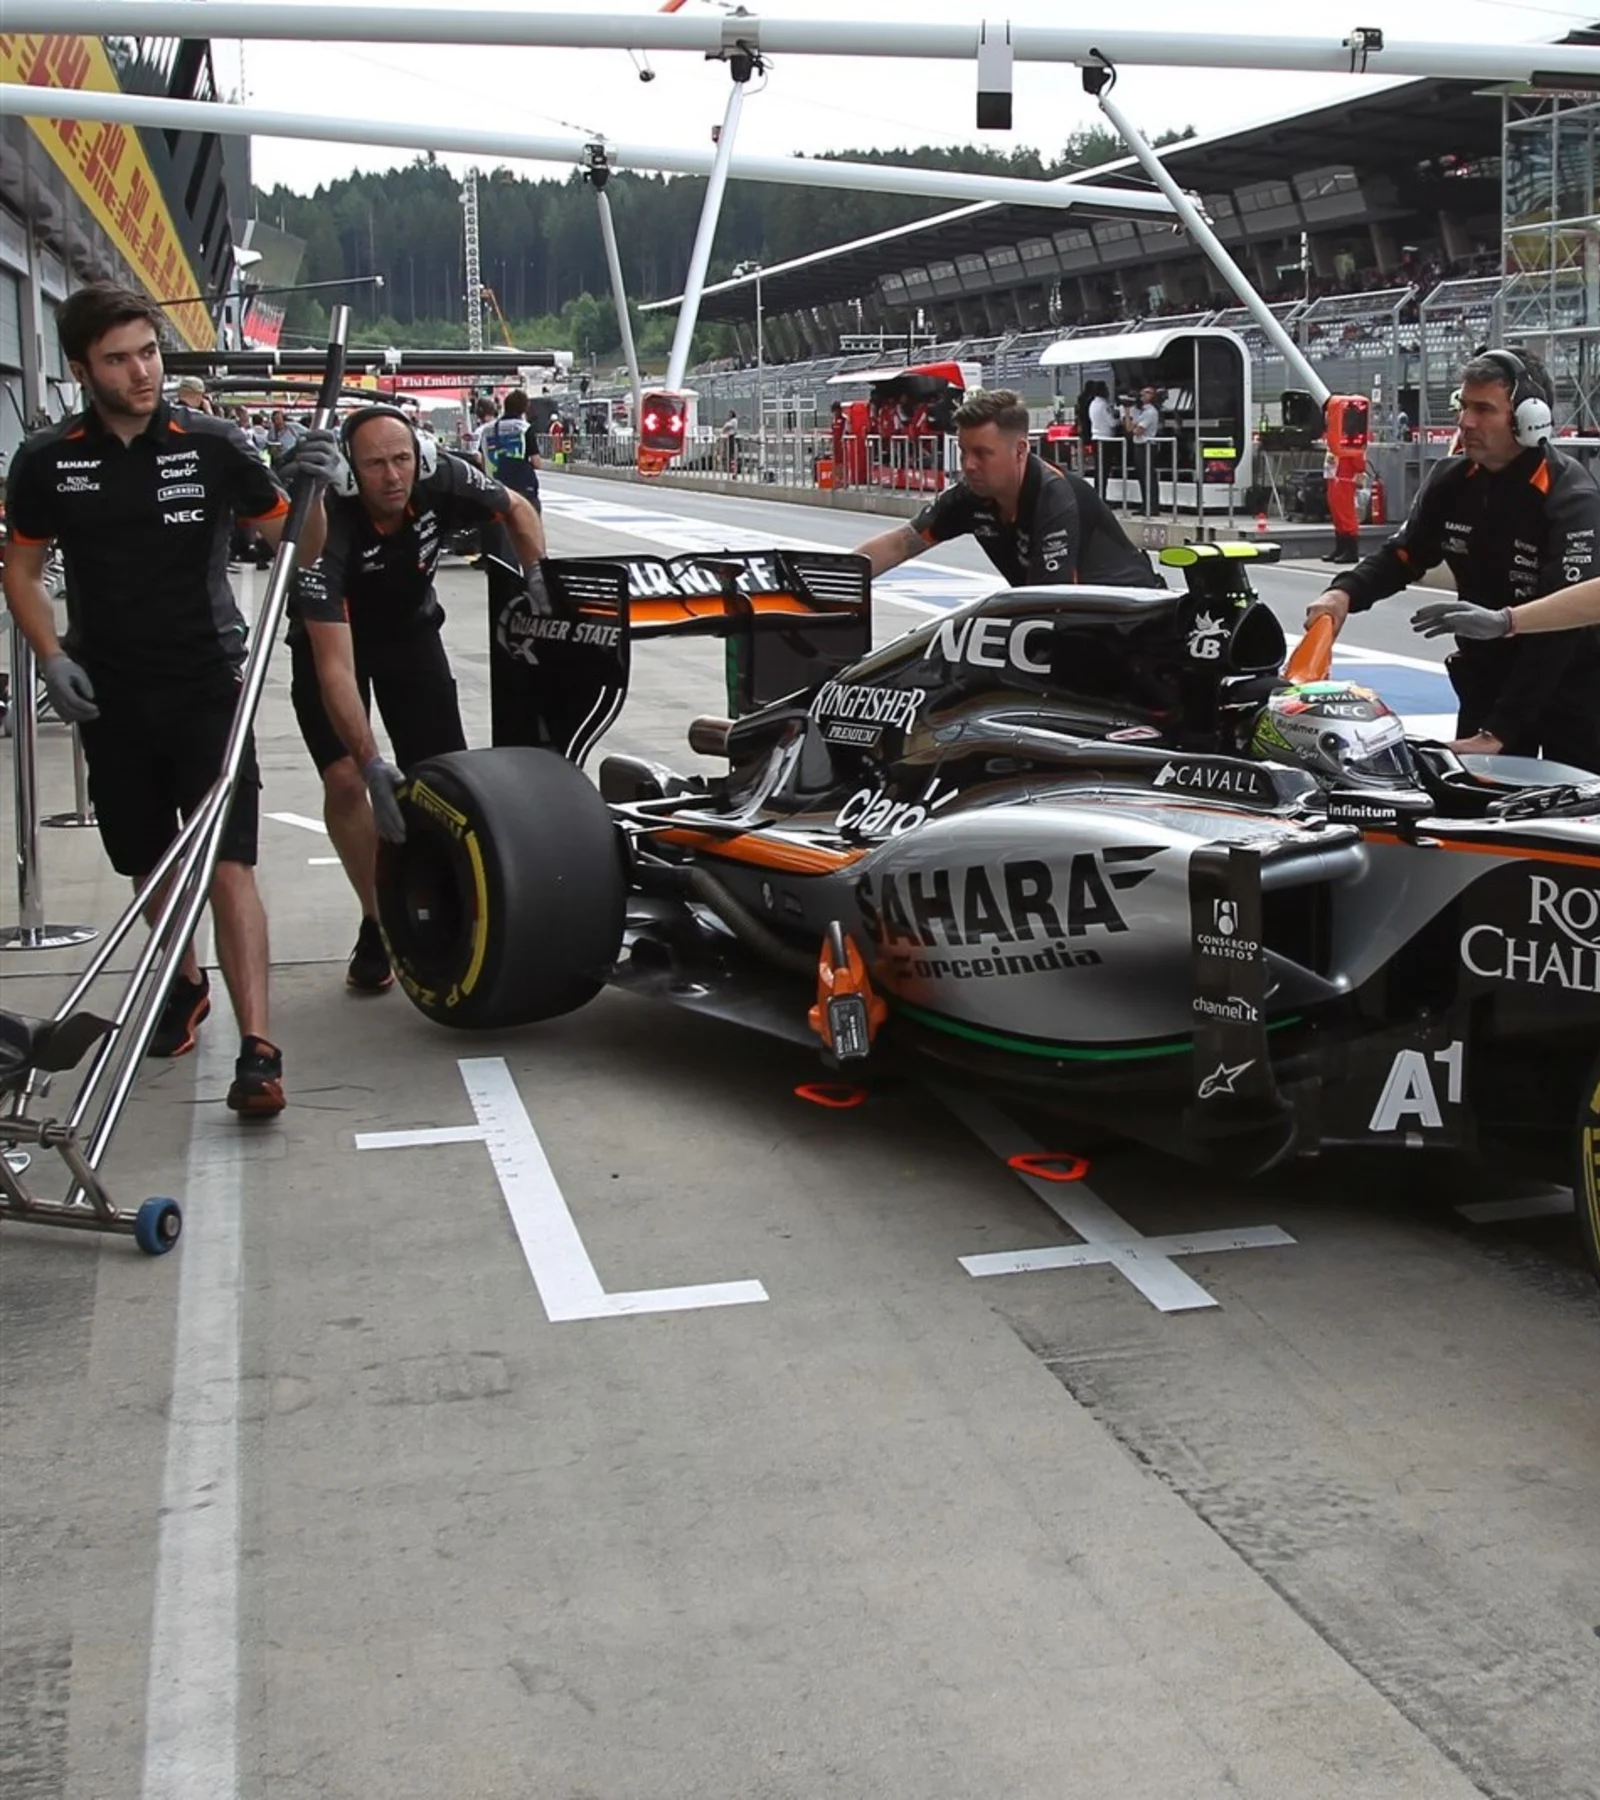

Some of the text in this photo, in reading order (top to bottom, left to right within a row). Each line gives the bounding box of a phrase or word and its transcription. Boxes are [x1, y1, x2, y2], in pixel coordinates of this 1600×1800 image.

[161, 465, 193, 479] Claro
[164, 510, 204, 524] NEC
[509, 612, 622, 648] QUAKER STATE
[924, 617, 1055, 674] NEC
[808, 681, 926, 735] KINGFISHER
[1323, 704, 1367, 718] NEC
[828, 725, 876, 742] PREMIUM
[1176, 765, 1259, 795] CAVALL
[835, 787, 927, 835] Claro
[1329, 803, 1397, 818] infinitum
[855, 852, 1130, 948] SAHARA
[1192, 997, 1258, 1021] channel it
[1368, 1040, 1464, 1132] A1
